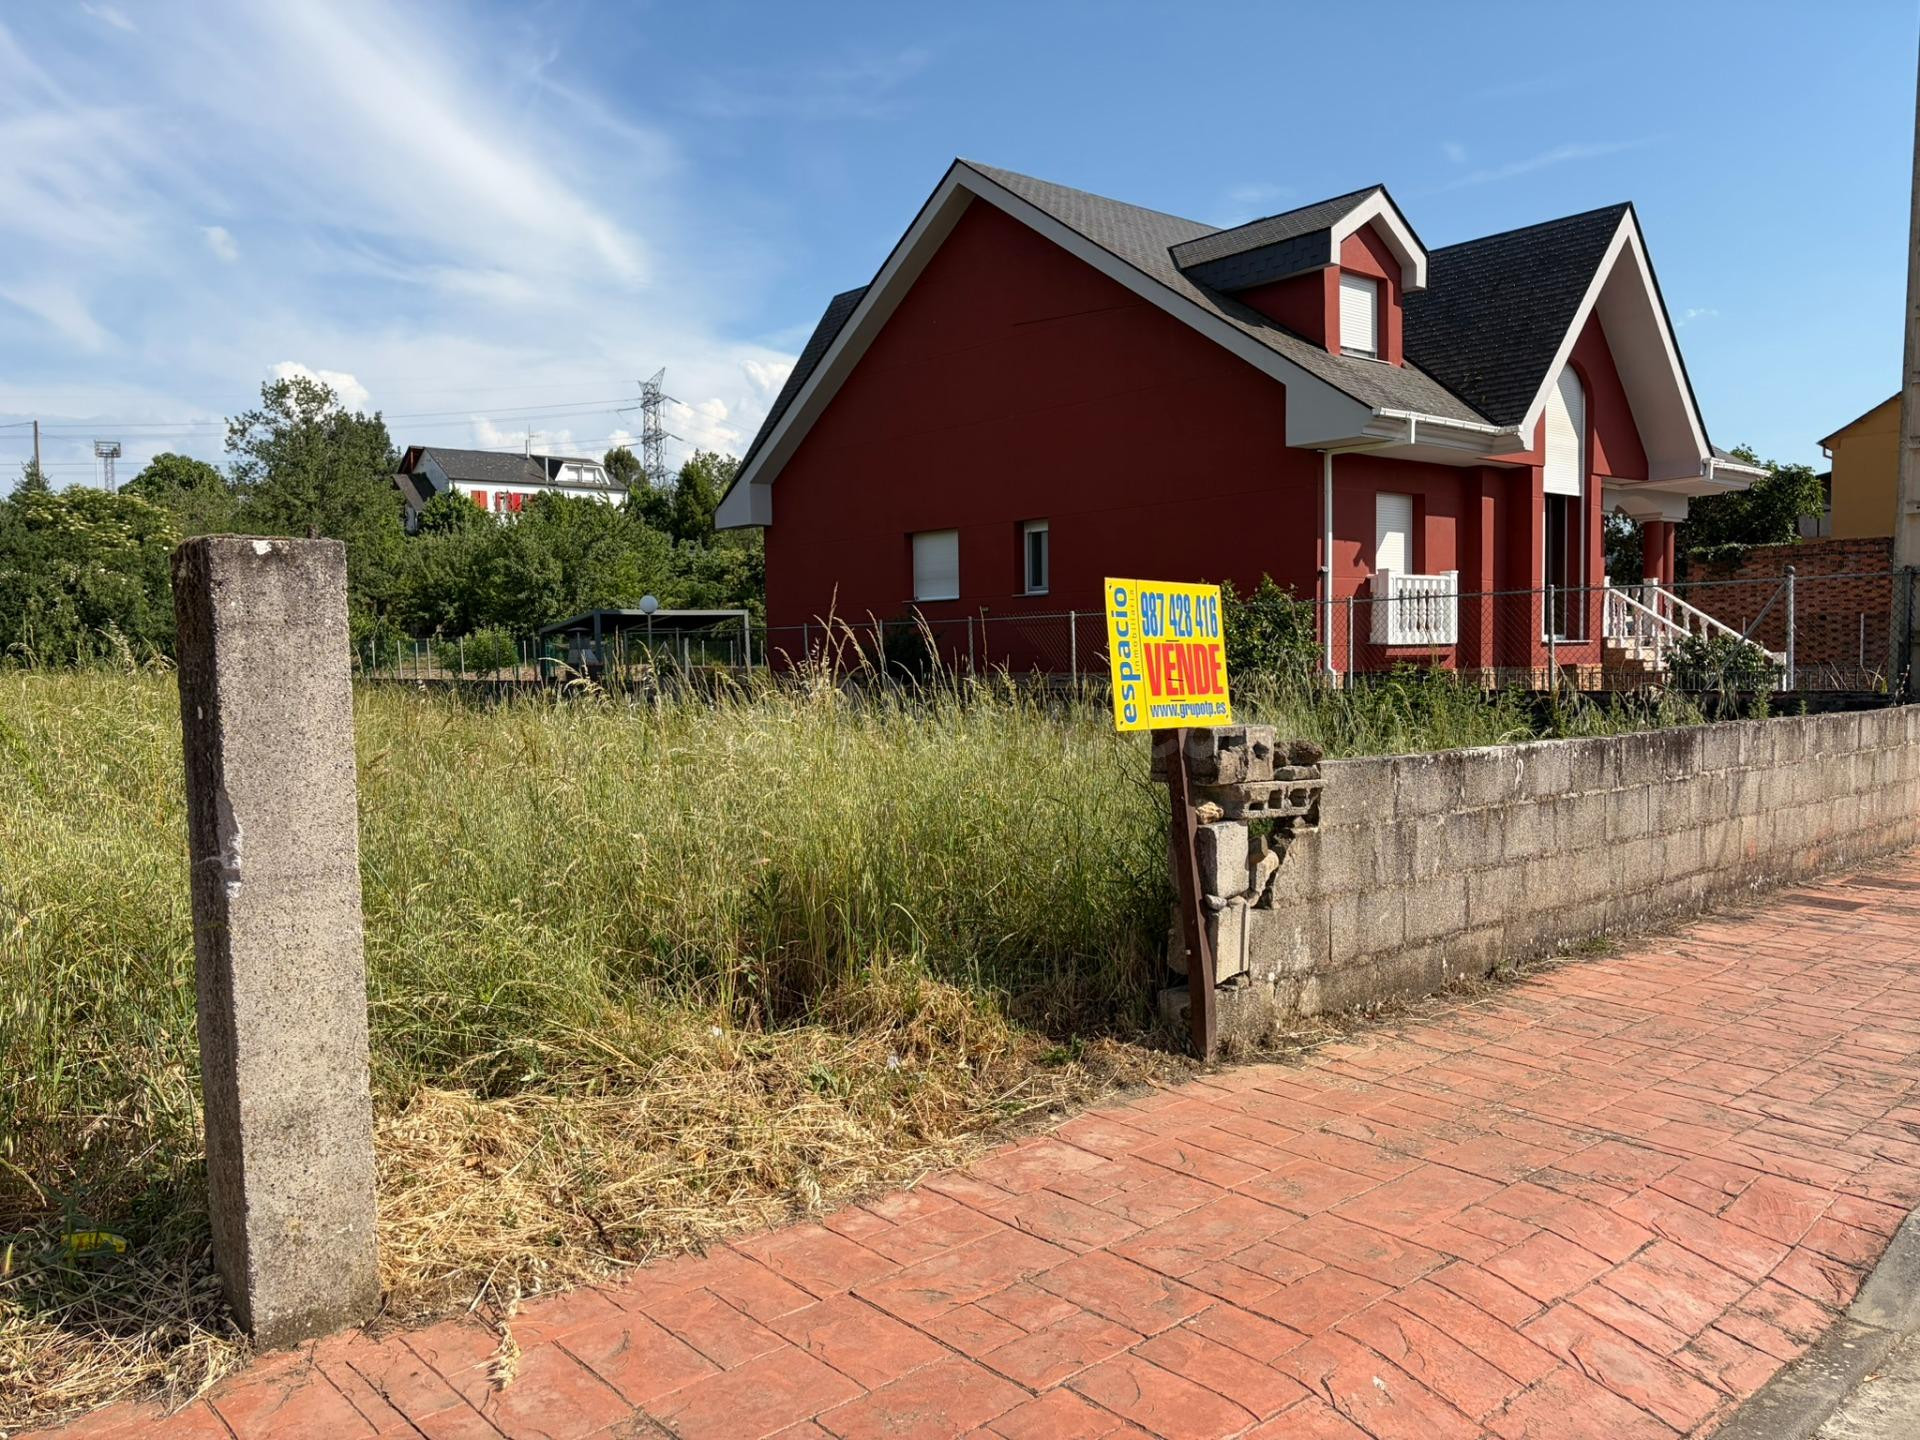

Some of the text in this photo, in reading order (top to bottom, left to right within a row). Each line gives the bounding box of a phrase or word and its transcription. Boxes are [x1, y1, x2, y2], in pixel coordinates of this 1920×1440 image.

[1130, 590, 1140, 671] inmobiliaria
[1141, 592, 1218, 638] 987 428 416
[1112, 587, 1141, 723] espacio
[1144, 643, 1224, 696] VENDE
[1150, 701, 1226, 718] www.grupotp.es
